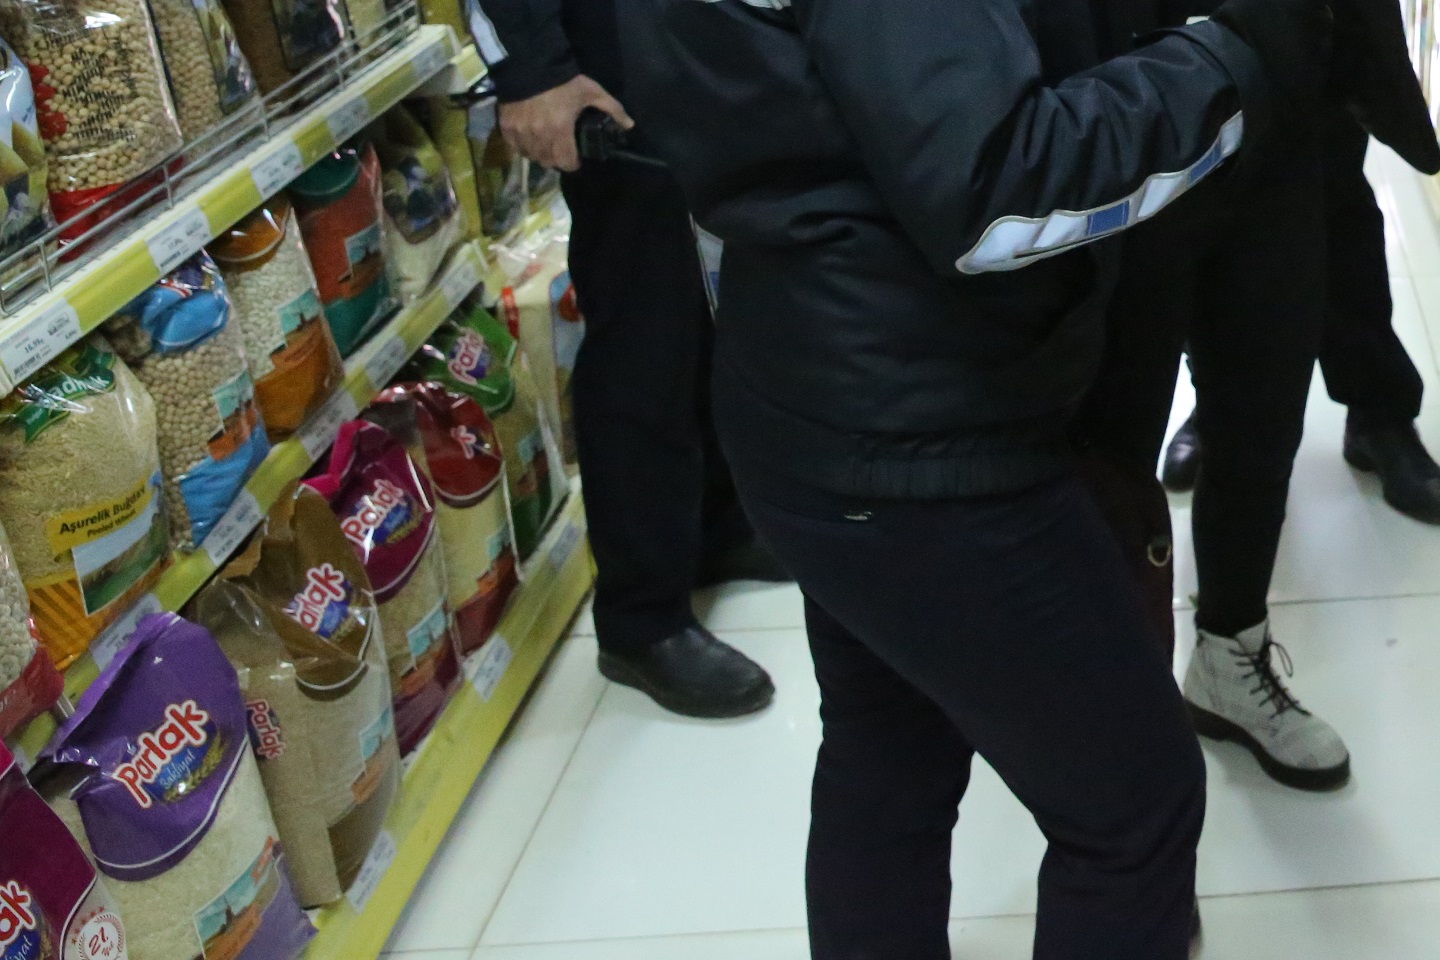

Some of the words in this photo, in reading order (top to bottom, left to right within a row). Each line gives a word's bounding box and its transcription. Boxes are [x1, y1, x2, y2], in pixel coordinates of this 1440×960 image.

[59, 510, 111, 535] Aşurelik
[116, 701, 206, 807] Parlak
[249, 700, 286, 760] Parlak
